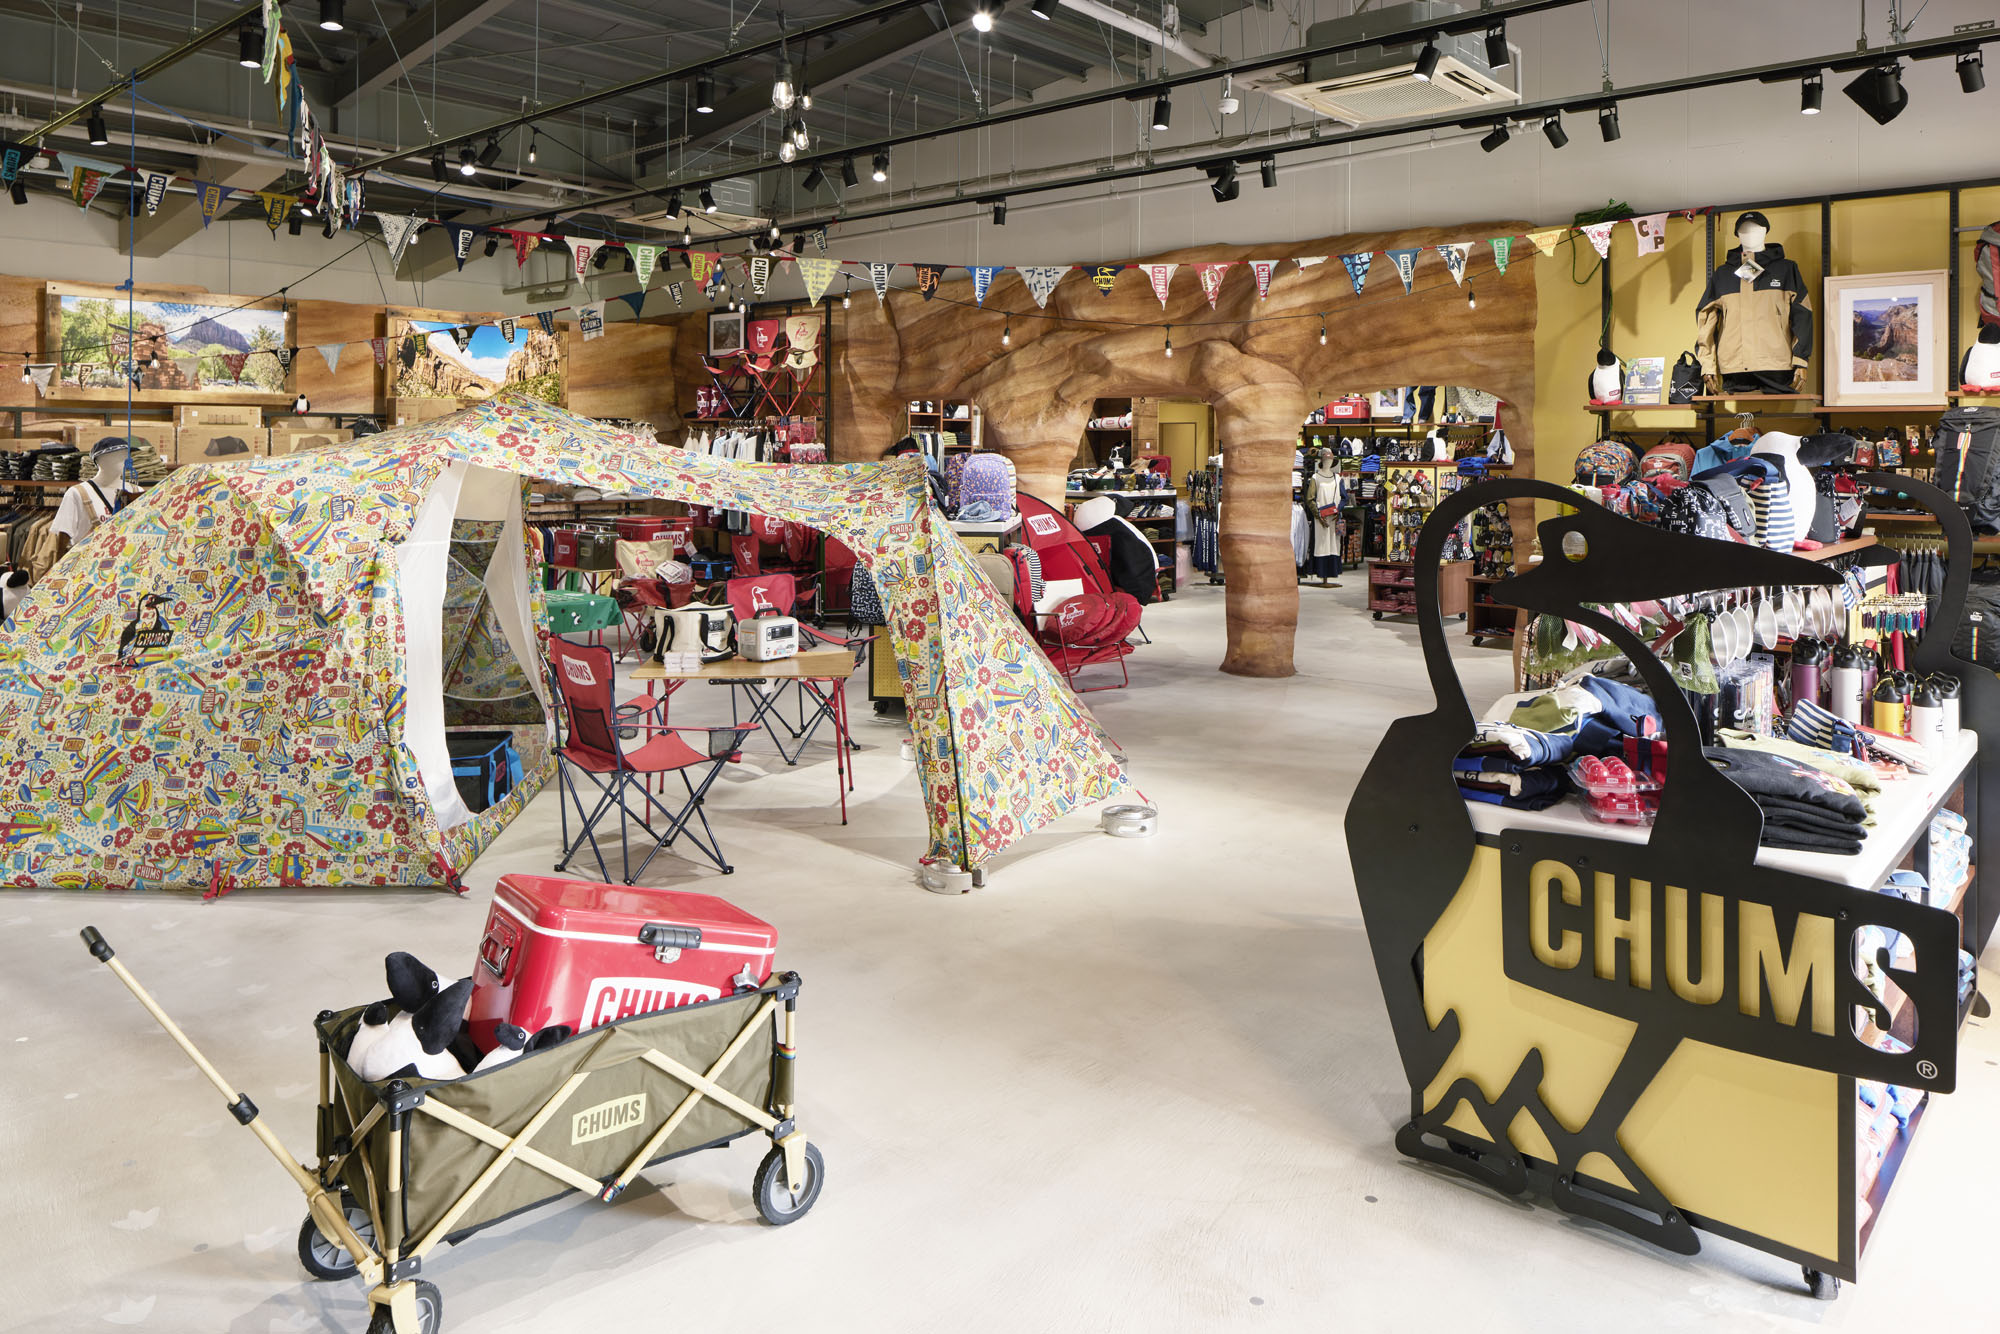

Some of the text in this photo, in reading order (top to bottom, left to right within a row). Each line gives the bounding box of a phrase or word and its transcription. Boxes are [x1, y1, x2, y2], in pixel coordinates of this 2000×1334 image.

[146, 176, 165, 210] CHUMS
[205, 188, 218, 215] CHUMS
[270, 199, 284, 225] CHUMS
[460, 232, 472, 257] CHUMS
[1496, 239, 1506, 272] CHUMS
[577, 247, 589, 273] CHUMS
[640, 248, 654, 281] CHUMS
[693, 255, 705, 280] CHUMS
[1402, 256, 1411, 281] CHUMS
[753, 259, 767, 294] CHUMS
[874, 263, 887, 297] CHUMS
[920, 267, 931, 291] CHUMS
[978, 268, 990, 299] CHUMS
[1153, 267, 1166, 299] CHUMS
[1257, 265, 1270, 297] CHUMS
[671, 283, 682, 304] CHUMS
[503, 320, 514, 343] CHUMS
[581, 319, 601, 330] CHUMS
[373, 340, 385, 367] CHUMS
[333, 498, 344, 521] CHUMS
[891, 523, 913, 534] CHUMS
[1031, 517, 1057, 532] CHUMS
[198, 612, 211, 637] CHUMS
[137, 632, 170, 646] CHUMS
[565, 660, 591, 681] CHUMS
[6, 803, 40, 813] FUTURE
[136, 865, 161, 881] CHUMS
[1530, 859, 1919, 1054] CHUMS
[578, 1101, 641, 1138] CHUMS
